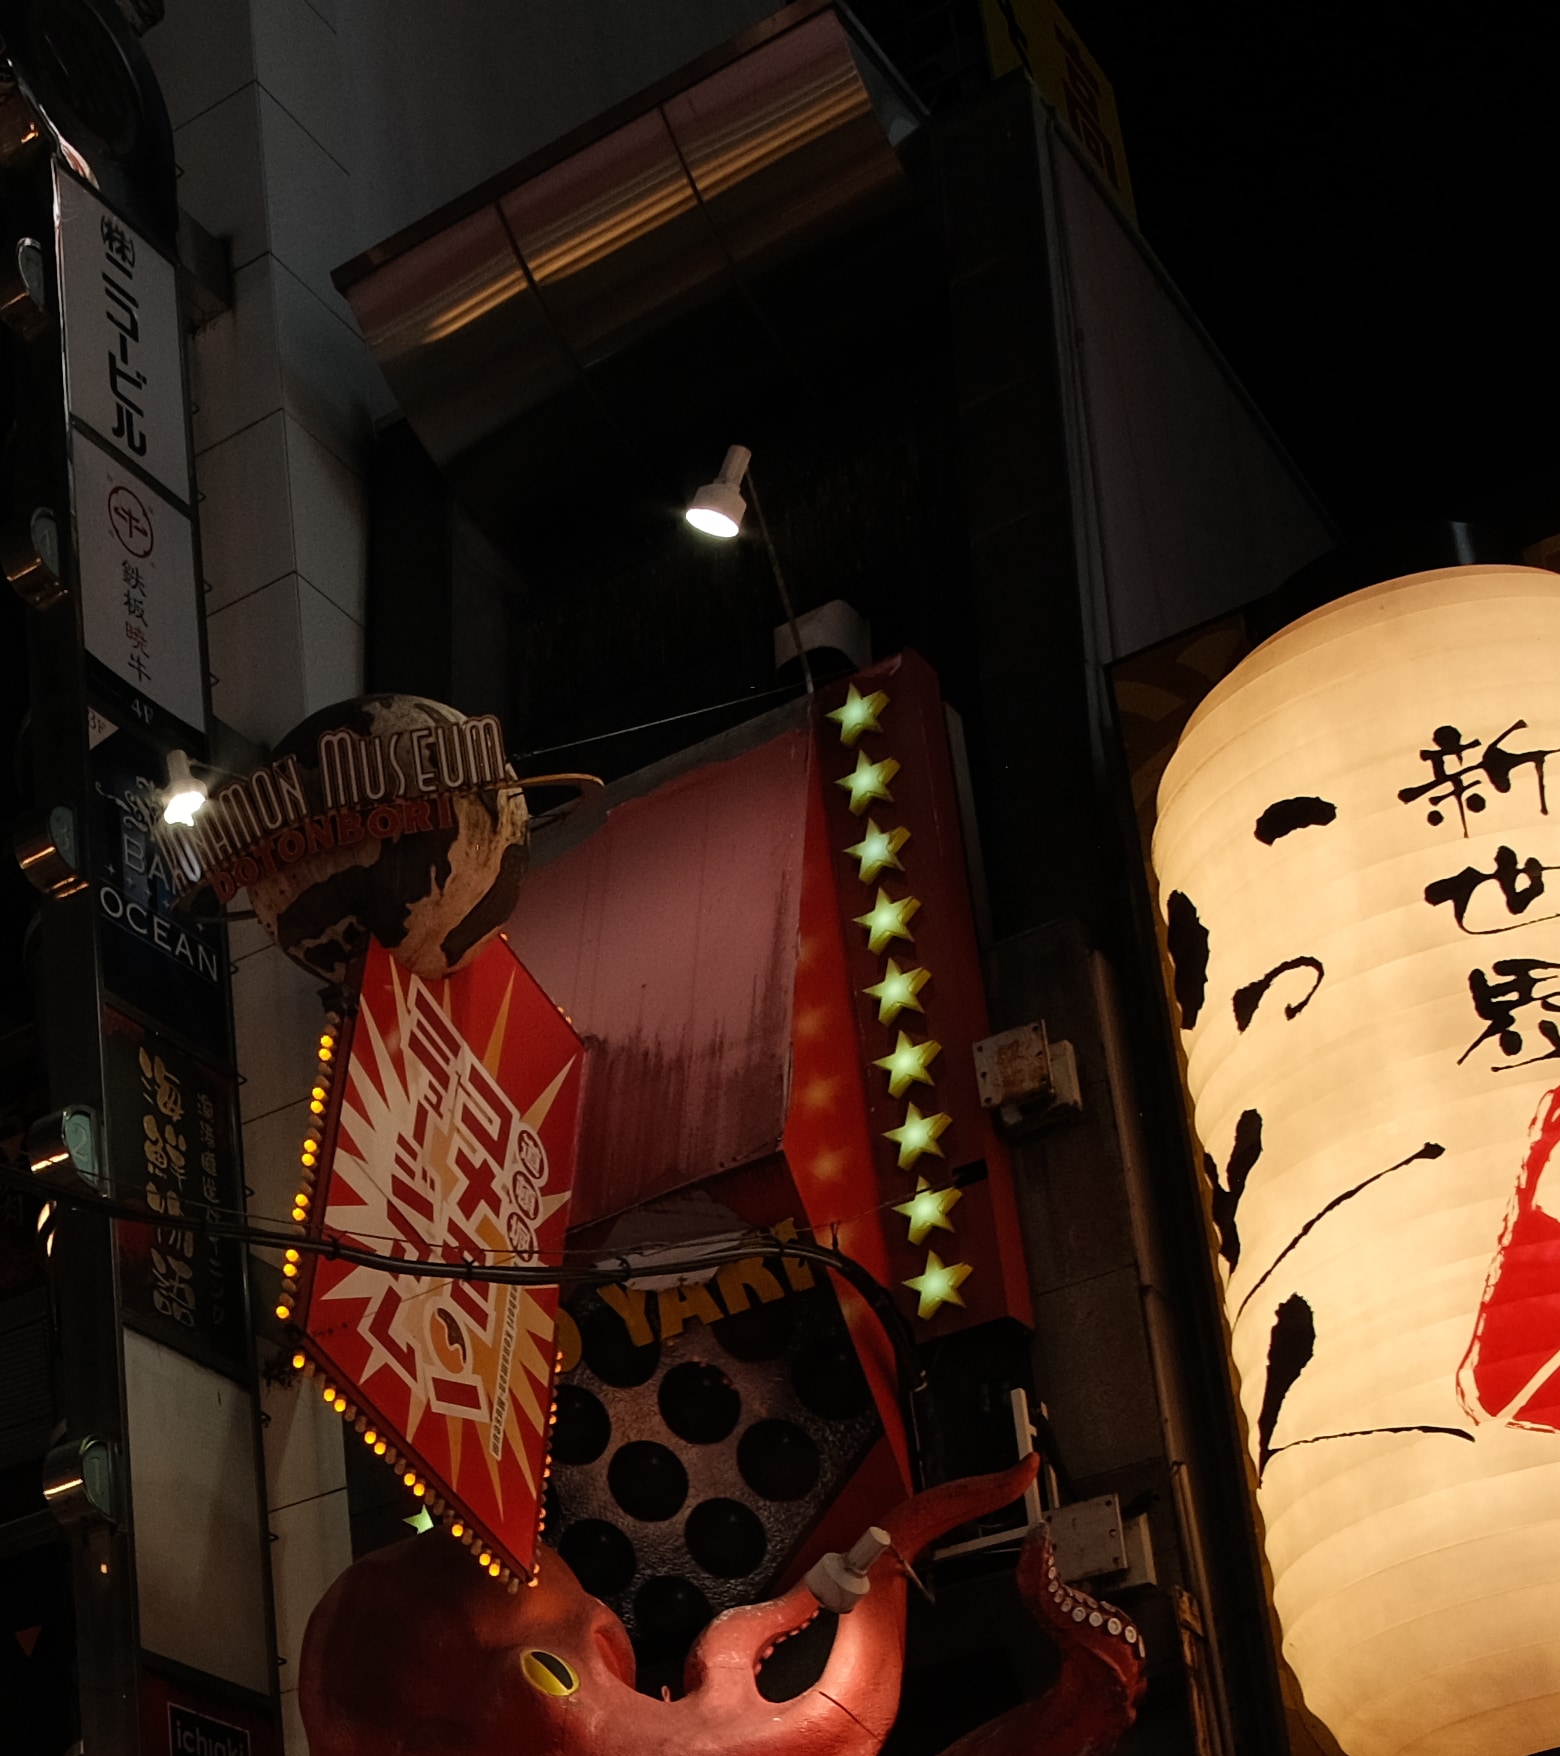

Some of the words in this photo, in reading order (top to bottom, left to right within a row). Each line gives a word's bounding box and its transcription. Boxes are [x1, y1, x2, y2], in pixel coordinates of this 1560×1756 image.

[131, 699, 154, 726] 4F
[318, 714, 506, 808] MUSEUM
[213, 795, 457, 902] DOTONBORI
[99, 885, 219, 983] OCEAN
